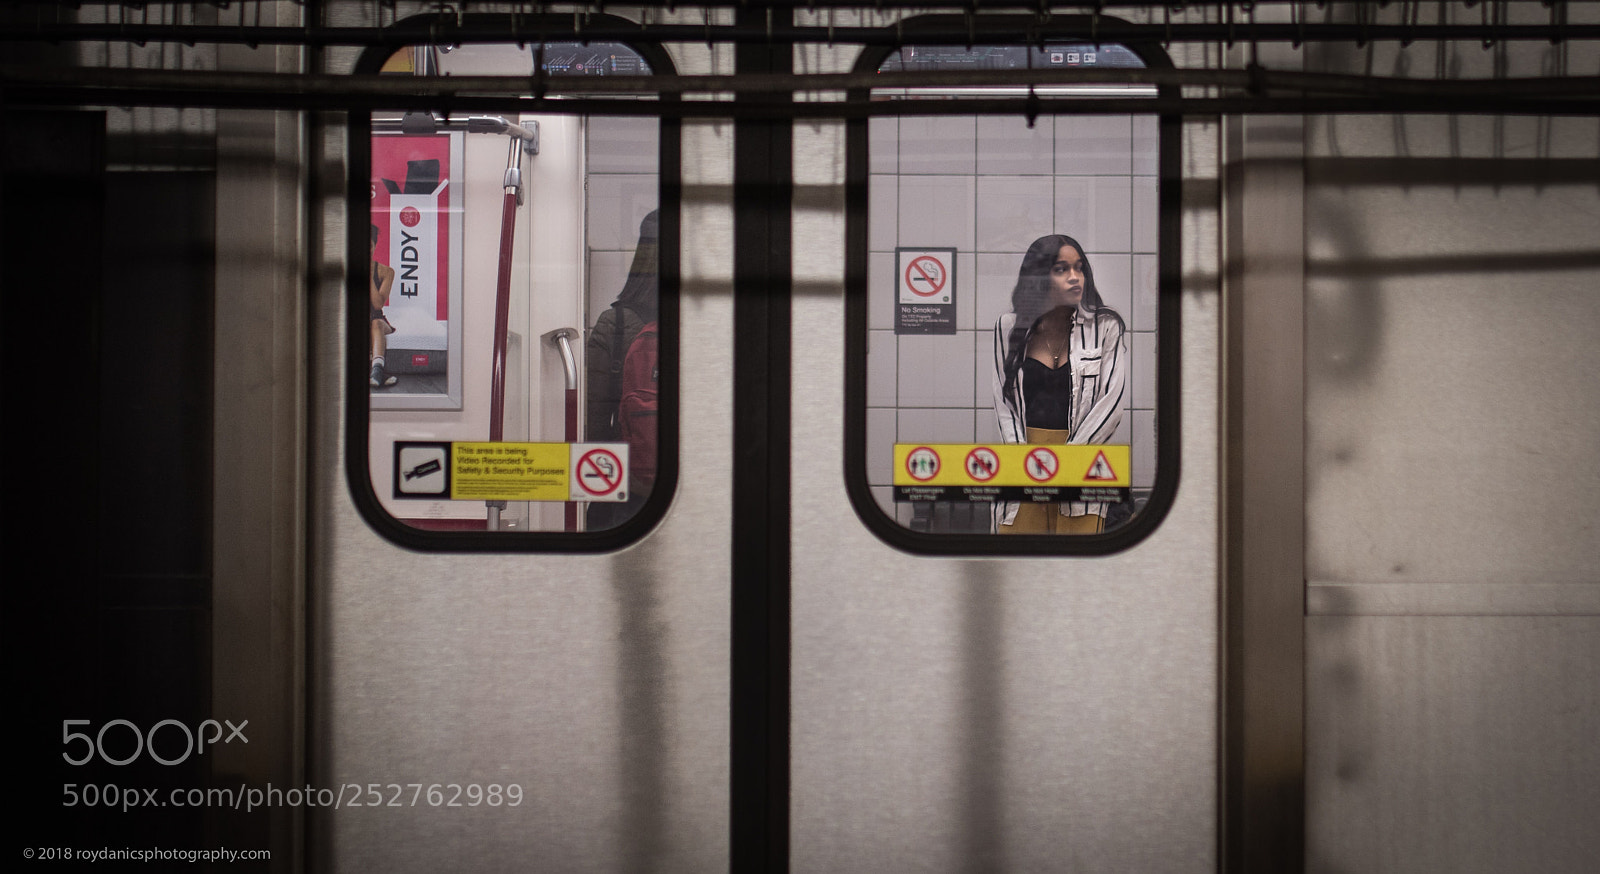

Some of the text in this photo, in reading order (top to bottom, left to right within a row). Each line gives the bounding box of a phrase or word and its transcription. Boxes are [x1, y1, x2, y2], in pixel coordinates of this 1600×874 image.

[401, 230, 419, 299] ENDY
[458, 447, 474, 455] This
[504, 448, 528, 457] being
[457, 457, 480, 465] Video
[481, 457, 521, 465] Recorded
[457, 466, 566, 476] Safety & Security Purposes
